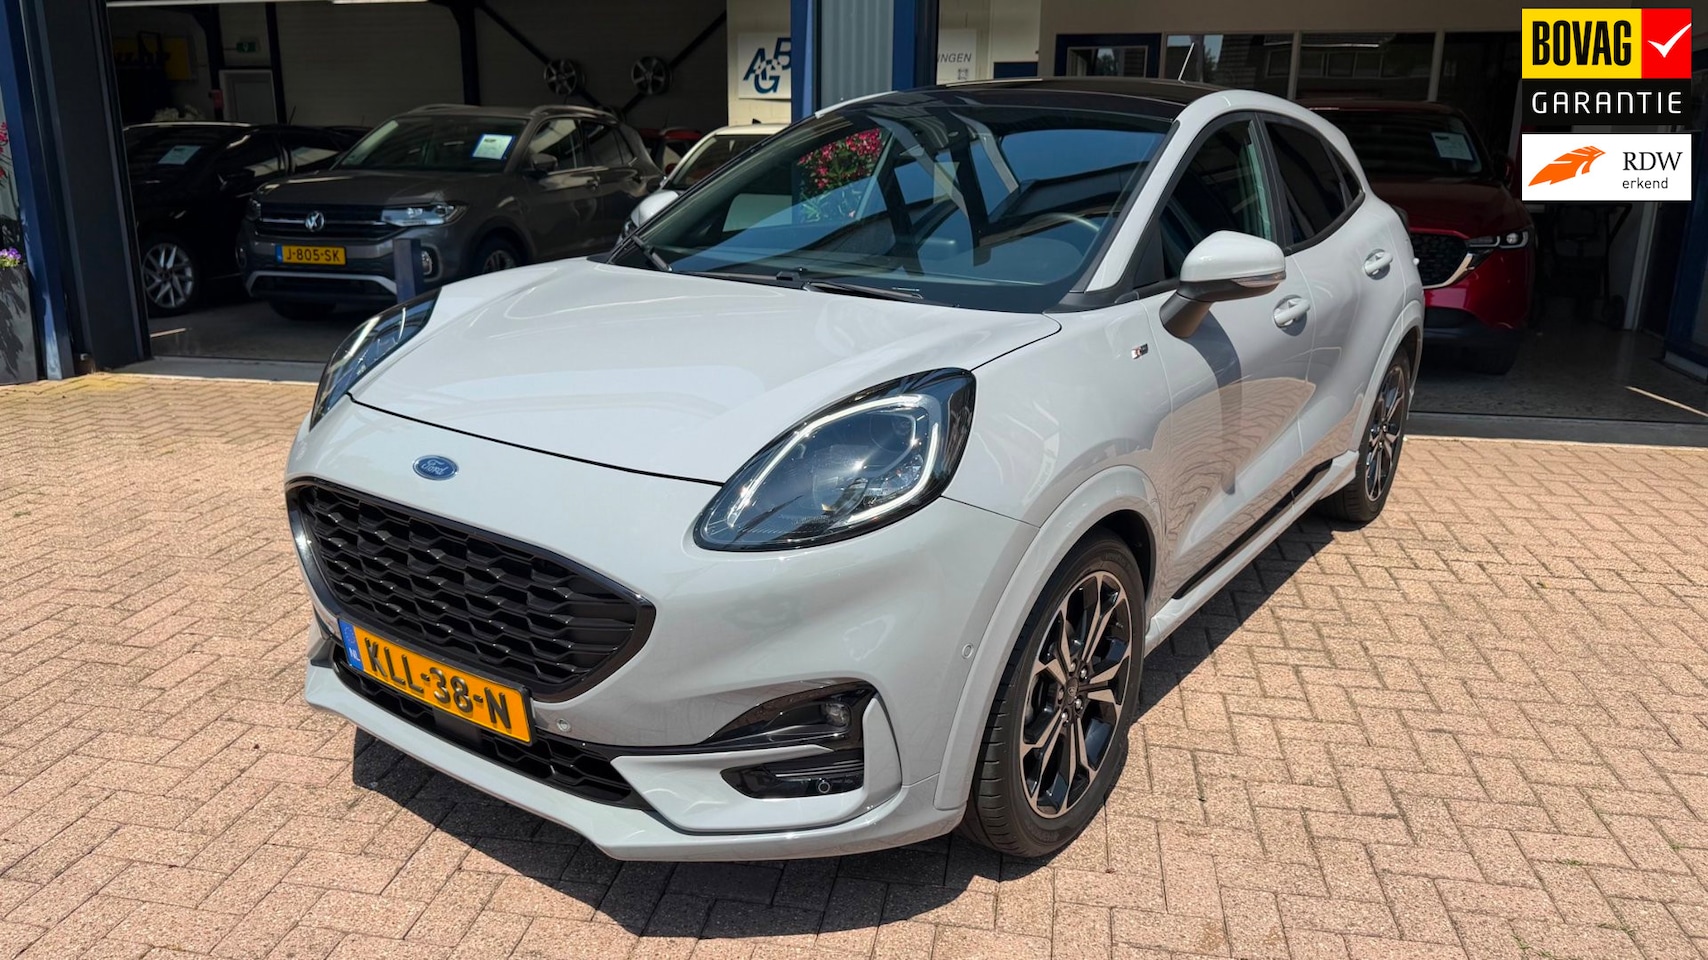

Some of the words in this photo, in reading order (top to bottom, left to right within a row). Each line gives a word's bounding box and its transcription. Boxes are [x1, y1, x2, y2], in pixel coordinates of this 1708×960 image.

[286, 248, 340, 262] J-805-SK
[420, 459, 449, 475] Ford
[364, 637, 512, 730] KLL-38-N
